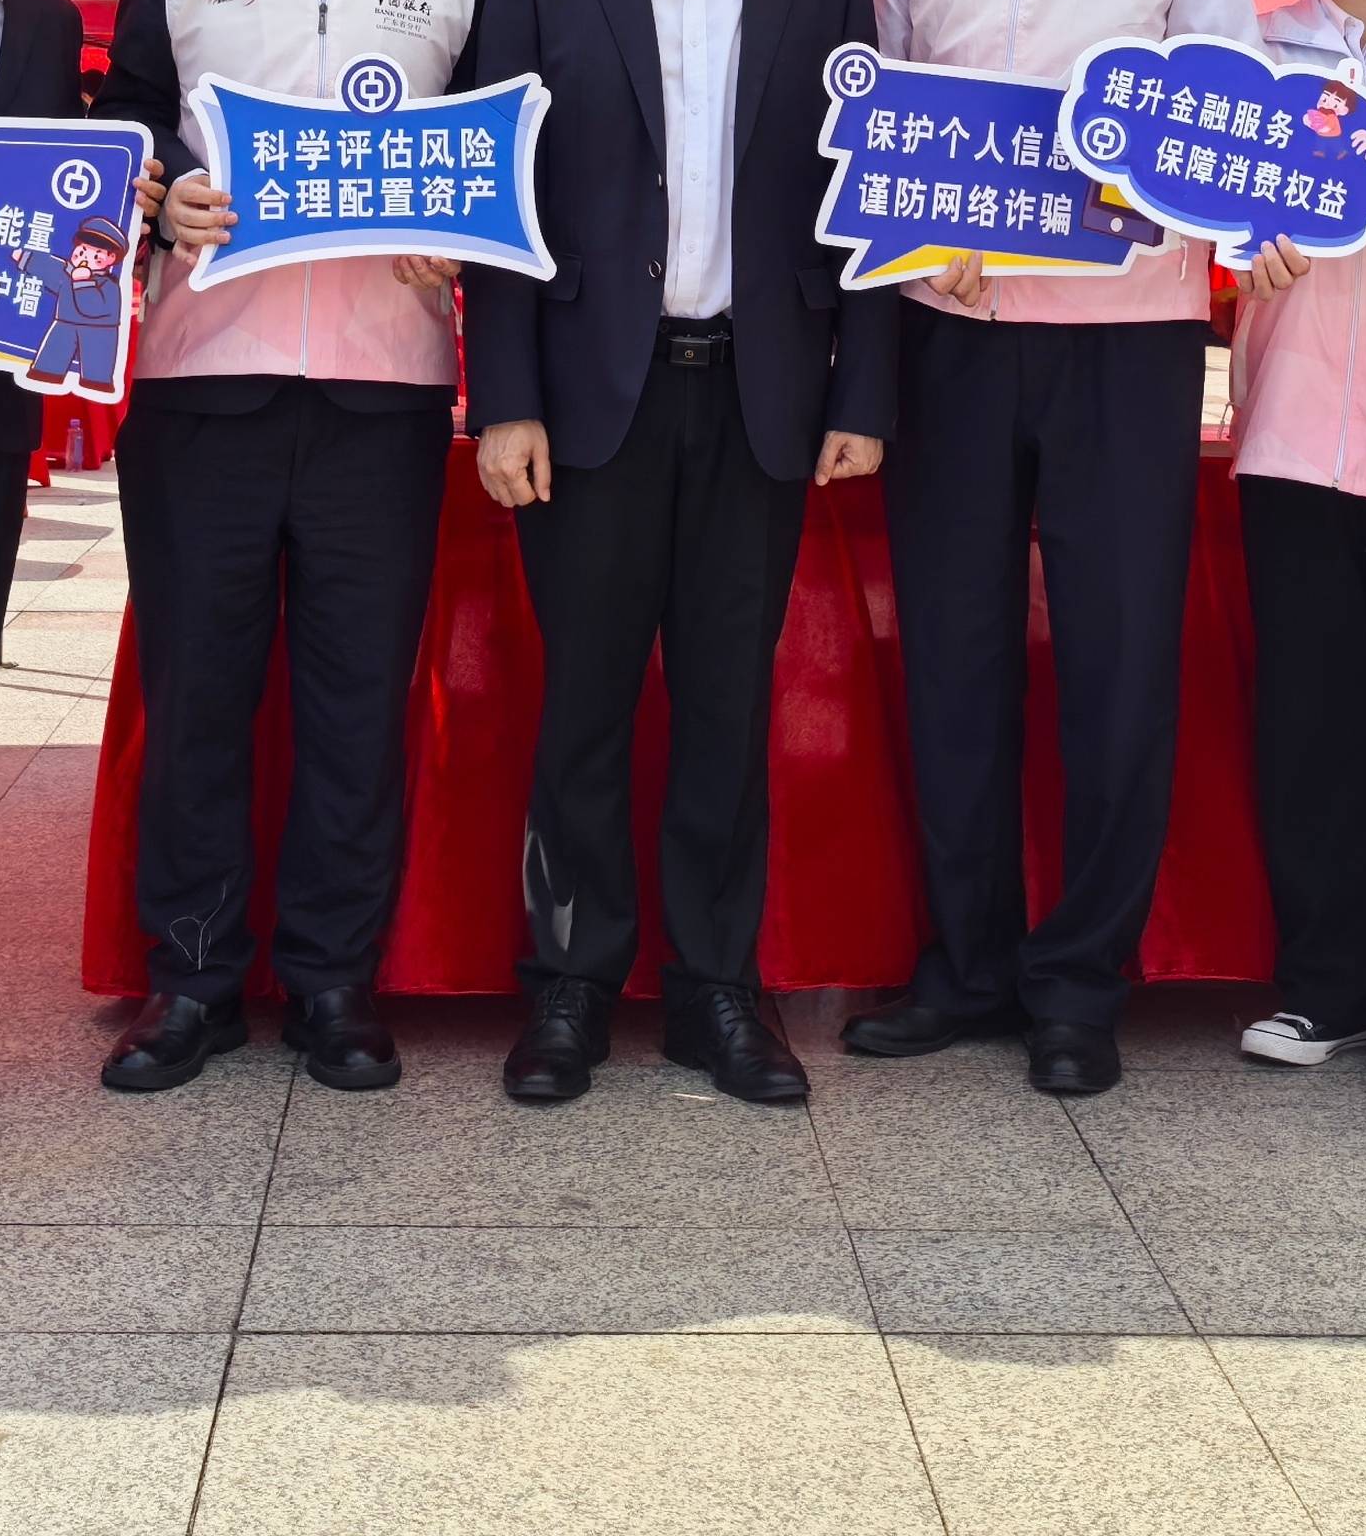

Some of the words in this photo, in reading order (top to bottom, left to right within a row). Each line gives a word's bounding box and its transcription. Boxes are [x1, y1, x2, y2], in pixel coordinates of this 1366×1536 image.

[408, 15, 431, 25] CHINA
[866, 108, 1075, 171] 保护个人信息
[1102, 67, 1295, 150] 提升金融服务
[253, 127, 497, 171] 科学评估风险
[1155, 136, 1348, 221] 保障消费权益
[254, 175, 497, 221] 合理配置资产
[858, 173, 1073, 236] 谨防网络诈骗
